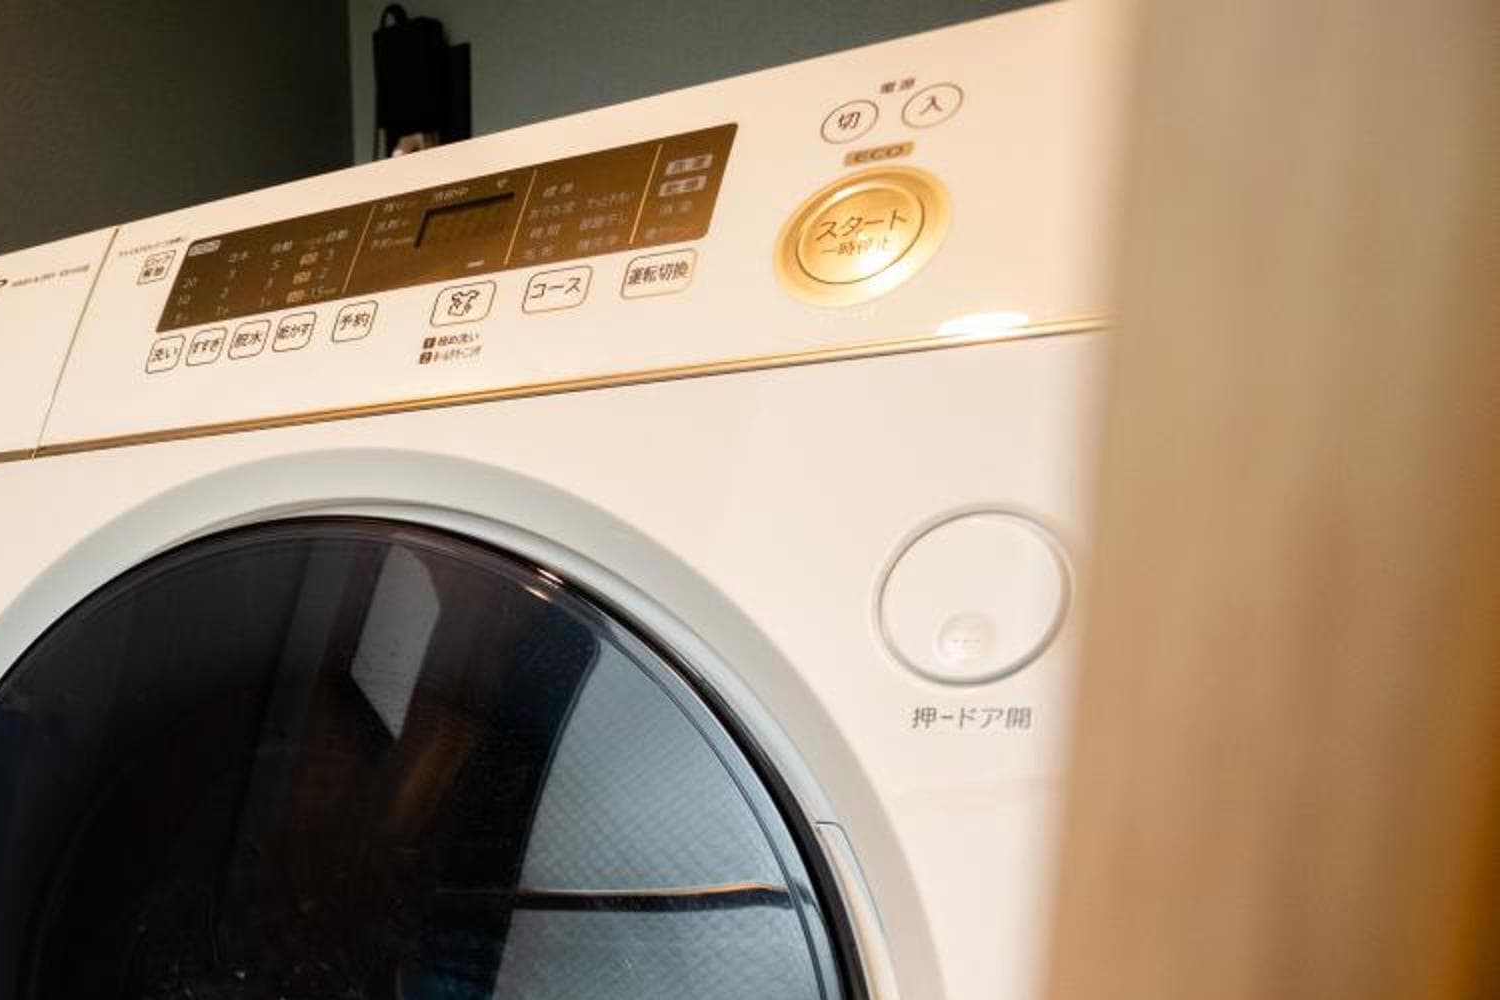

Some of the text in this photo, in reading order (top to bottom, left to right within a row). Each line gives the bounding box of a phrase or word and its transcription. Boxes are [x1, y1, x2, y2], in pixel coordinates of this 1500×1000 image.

[919, 95, 944, 116] 入
[837, 110, 862, 130] 切
[815, 208, 908, 242] スタート
[627, 260, 690, 286] 運転切換
[530, 276, 582, 300] コース
[340, 311, 372, 331] 予約
